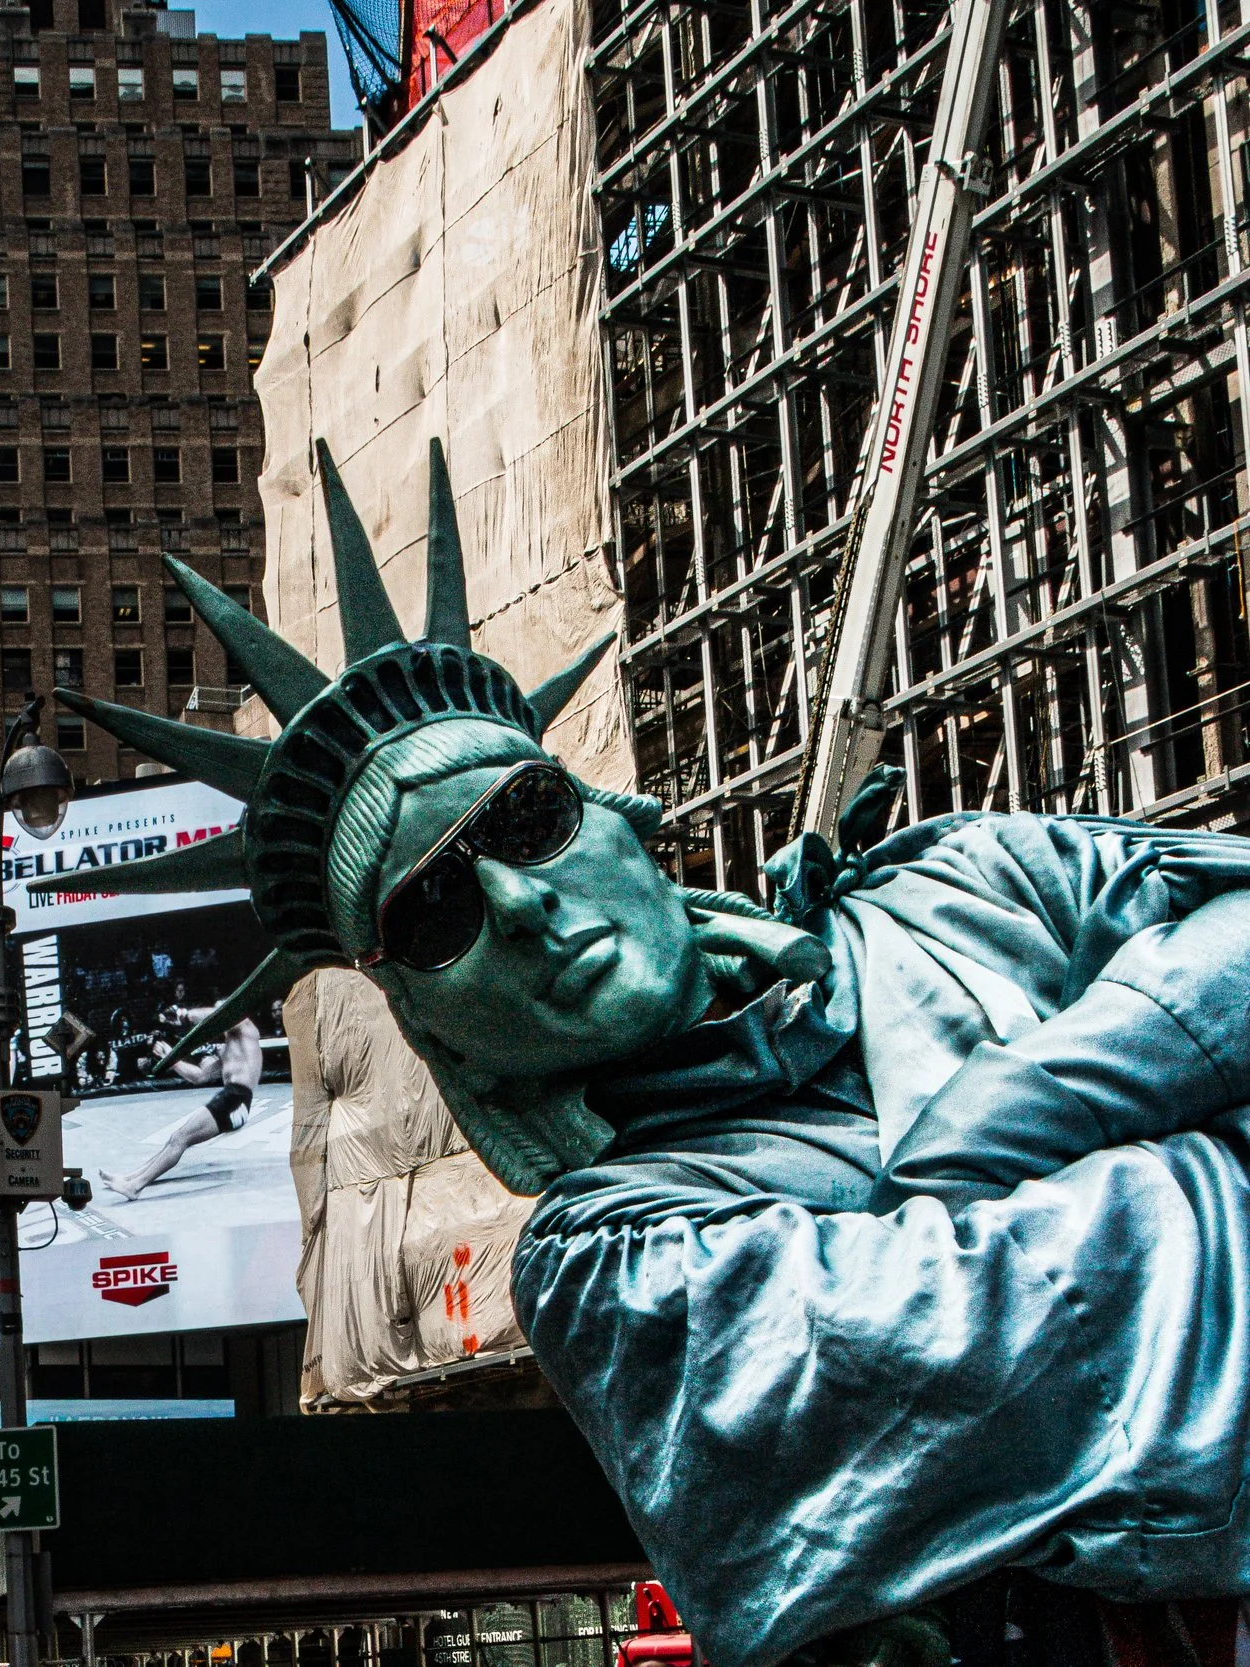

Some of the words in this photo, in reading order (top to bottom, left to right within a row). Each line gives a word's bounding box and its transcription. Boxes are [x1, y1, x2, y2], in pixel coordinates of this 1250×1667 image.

[880, 358, 914, 474] NORTH
[905, 230, 938, 345] SHORE
[60, 826, 99, 840] SPIKE
[109, 814, 176, 832] PRESENTS
[91, 1264, 178, 1289] SPIKE
[29, 1466, 50, 1486] St
[433, 1634, 456, 1647] HOTEL
[481, 1629, 523, 1643] ENTRANCE
